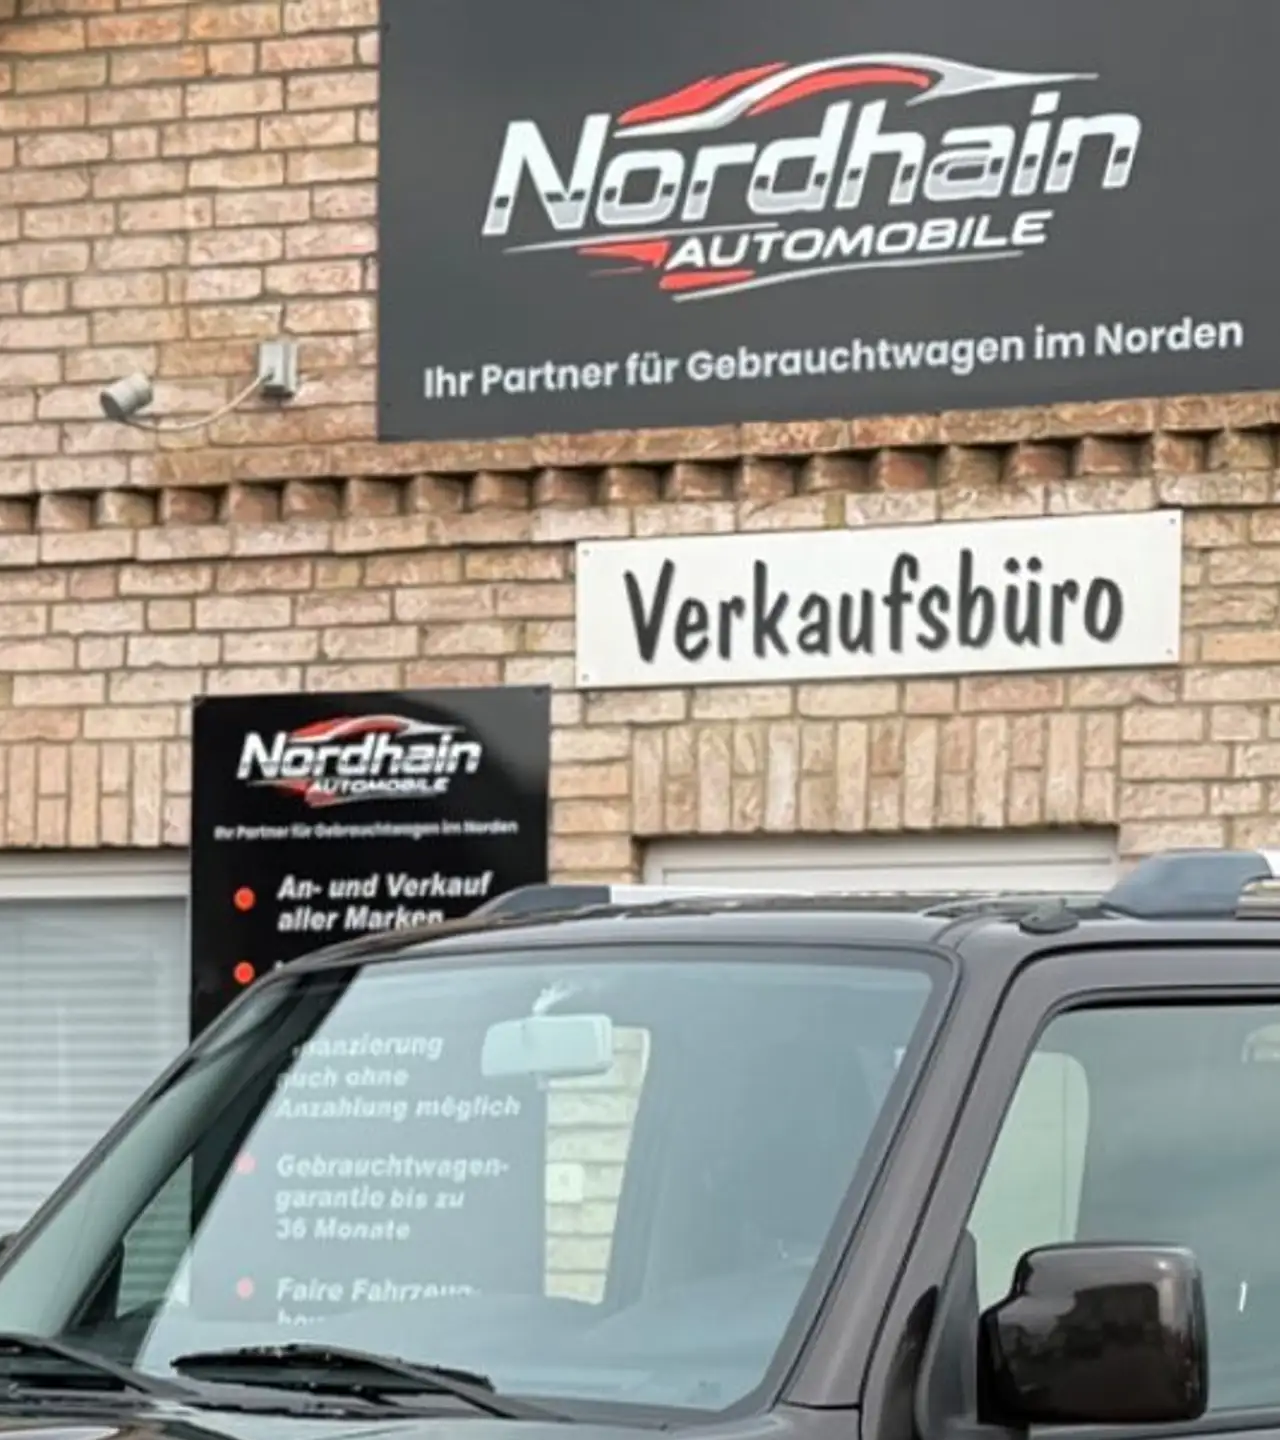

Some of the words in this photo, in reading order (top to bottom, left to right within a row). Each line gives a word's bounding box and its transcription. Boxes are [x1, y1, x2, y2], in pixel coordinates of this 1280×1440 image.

[481, 93, 1142, 237] Nordhain
[666, 210, 1054, 270] AUTOMOBILE
[423, 364, 473, 399] Ihr
[481, 357, 618, 397] Partner
[626, 349, 679, 386] für
[687, 333, 1024, 384] Gebrauchtwagen
[1034, 324, 1085, 361] im
[1094, 316, 1244, 356] Norden
[623, 548, 1125, 664] Verkaufsbüro
[235, 730, 483, 780] Nordhain
[311, 776, 451, 794] AUTOMOBILE
[236, 823, 288, 840] Partner
[276, 873, 323, 899] An-
[328, 872, 379, 898] und
[385, 869, 494, 897] Verkauf
[277, 905, 339, 932] aller
[345, 1065, 410, 1088] ohne
[274, 1096, 408, 1123] Anzahlung
[414, 1094, 521, 1122] möglich
[276, 1152, 510, 1183] Gebrauchtwagen-
[275, 1184, 385, 1213] garantie
[390, 1186, 428, 1210] bis
[434, 1190, 465, 1210] zu
[276, 1217, 306, 1240] 36
[314, 1216, 411, 1241] Monate
[276, 1277, 344, 1303] Faire
